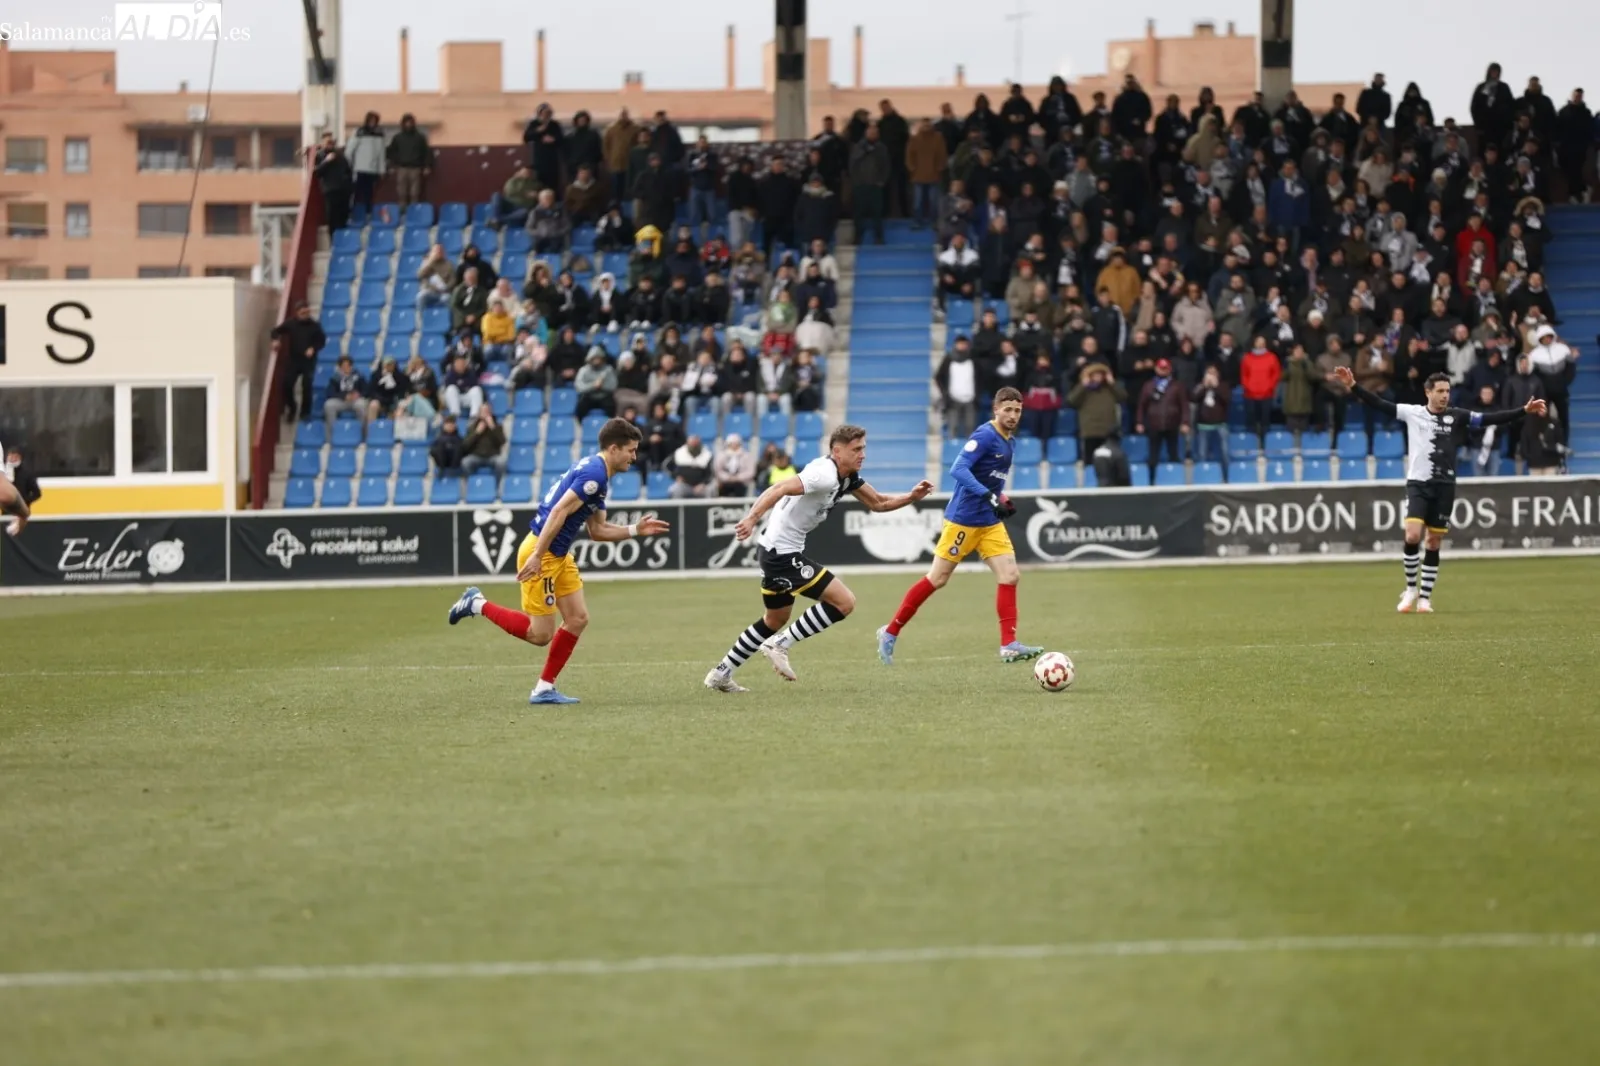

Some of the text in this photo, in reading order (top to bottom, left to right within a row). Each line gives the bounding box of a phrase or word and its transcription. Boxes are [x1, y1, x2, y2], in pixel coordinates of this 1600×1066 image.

[1209, 493, 1357, 537] SARDÓN
[1449, 497, 1497, 530] OS
[954, 530, 967, 546] 9
[1045, 524, 1159, 543] TARDAGUILA
[57, 522, 143, 571] Eider
[310, 534, 419, 555] recoletas salud
[542, 576, 555, 594] 16
